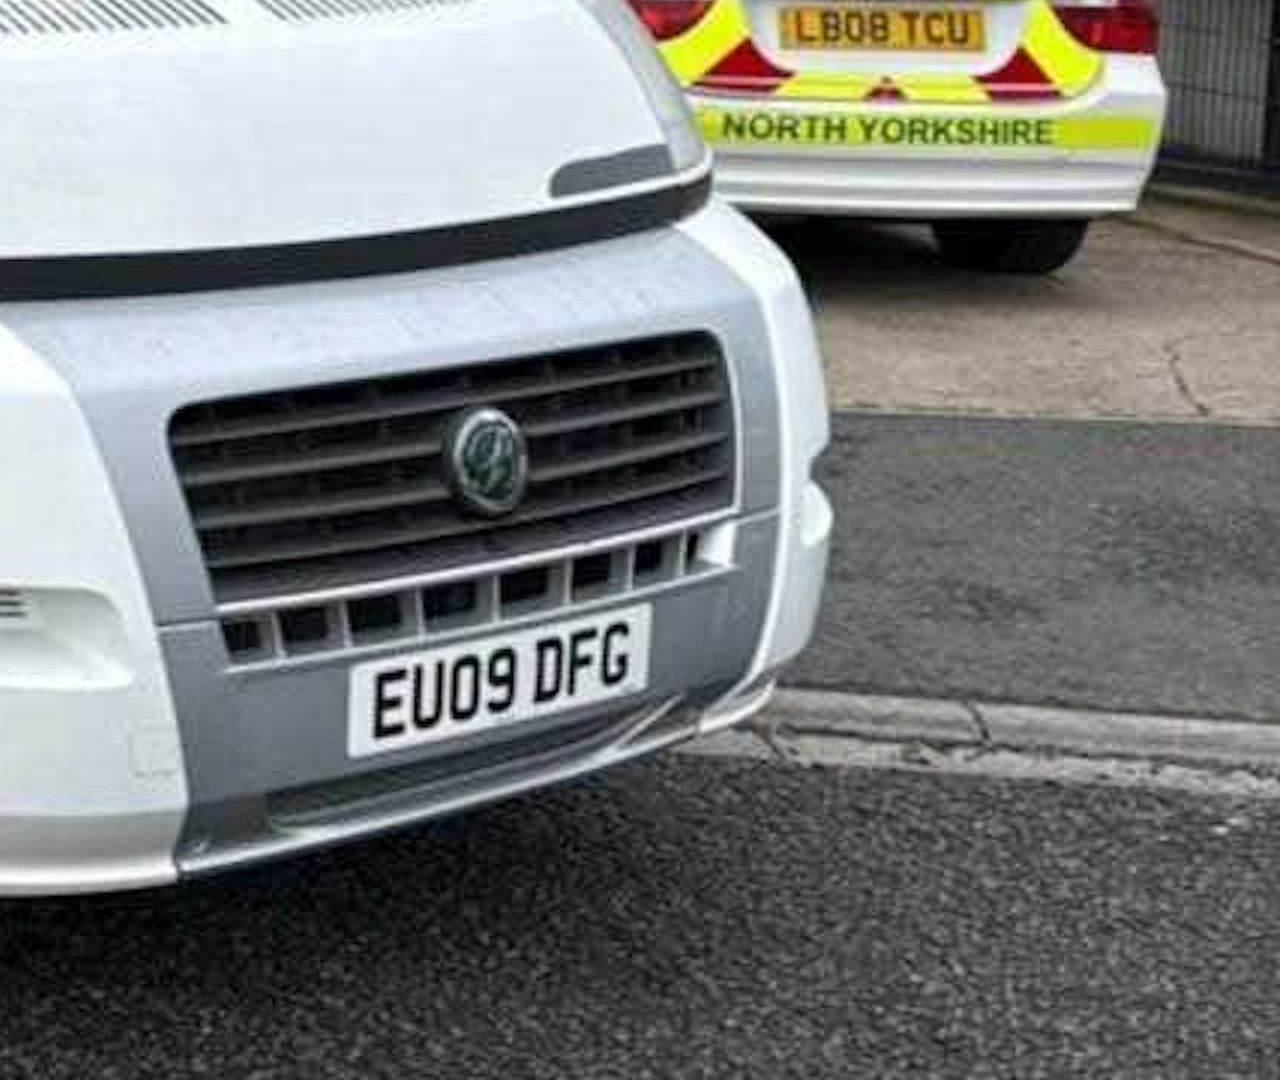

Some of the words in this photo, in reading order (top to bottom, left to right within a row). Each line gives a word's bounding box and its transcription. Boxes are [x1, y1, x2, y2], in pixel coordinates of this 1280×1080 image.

[794, 10, 890, 44] LB08
[902, 10, 971, 44] TCU
[723, 115, 847, 141] NORTH
[858, 118, 1055, 145] YORKSHIRE
[372, 645, 517, 740] EU09
[533, 622, 630, 704] DFG
